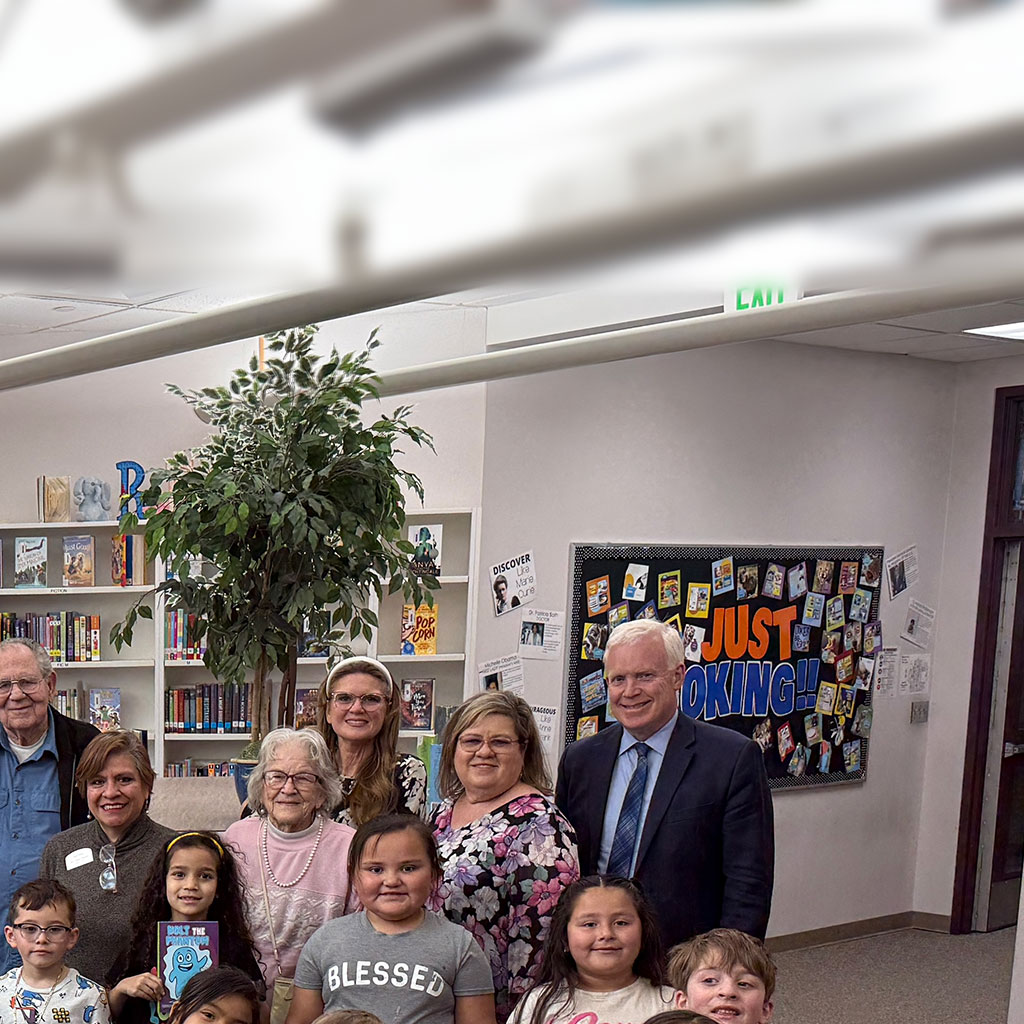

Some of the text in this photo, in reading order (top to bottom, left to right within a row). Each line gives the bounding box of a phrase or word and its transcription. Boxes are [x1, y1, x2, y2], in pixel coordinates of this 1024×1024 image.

[493, 554, 531, 576] DISCOVER
[416, 615, 435, 629] POP
[413, 627, 435, 643] CORN
[701, 603, 797, 662] JUST
[678, 657, 820, 719] OKING!!
[531, 706, 556, 715] RAGEOUS
[192, 927, 206, 936] THE
[327, 960, 445, 998] BLESSED
